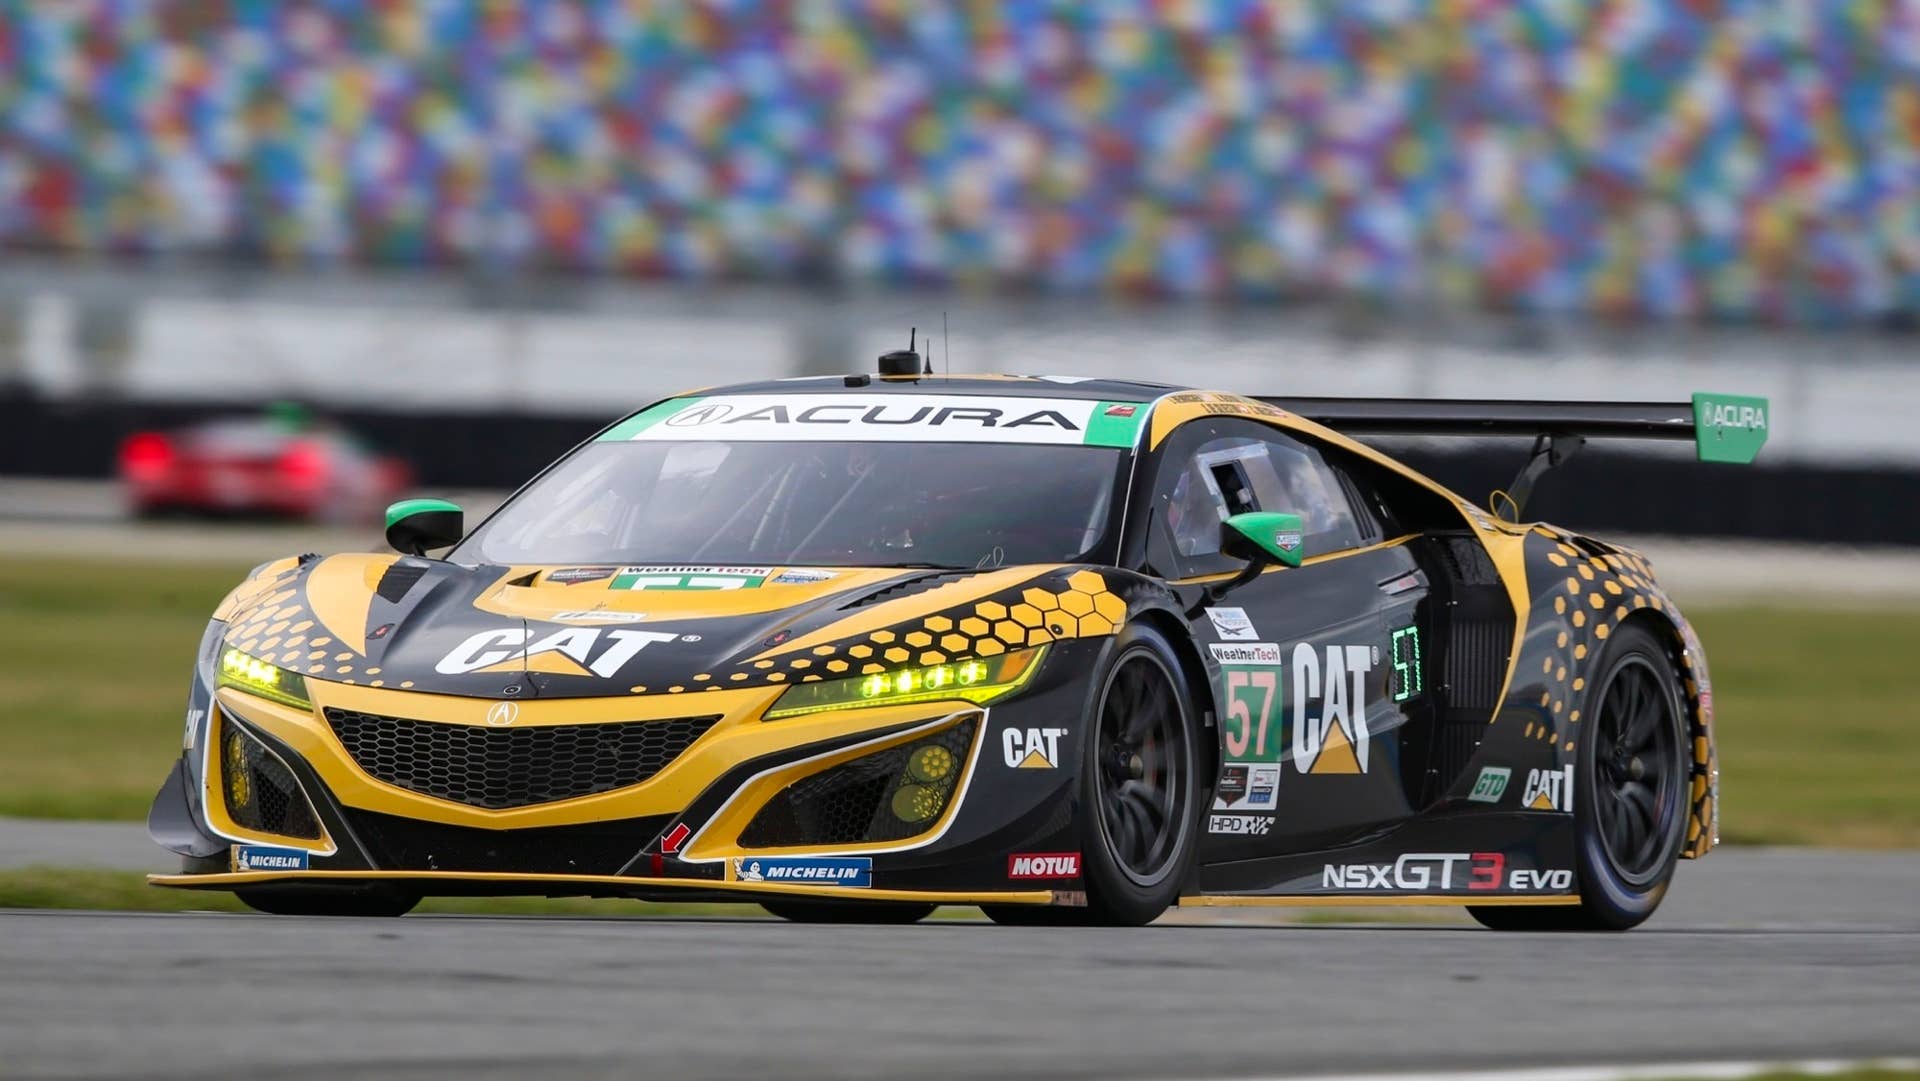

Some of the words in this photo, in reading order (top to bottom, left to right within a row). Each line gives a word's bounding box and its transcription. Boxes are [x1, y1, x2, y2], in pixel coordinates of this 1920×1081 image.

[721, 404, 1081, 430] ACURA
[1713, 404, 1766, 429] ACURA
[435, 628, 679, 679] CAT
[1212, 647, 1279, 660] WeatherTech
[1393, 626, 1421, 700] 57
[1226, 671, 1276, 758] 57
[1292, 642, 1371, 774] CAT
[1002, 728, 1062, 768] CAT
[1474, 773, 1506, 796] GTD
[1522, 768, 1564, 810] CAT
[1210, 817, 1242, 831] HPD
[250, 855, 301, 868] MICHELIN
[766, 866, 859, 879] MICHELIN
[1012, 856, 1077, 875] MOTUL
[1509, 870, 1573, 889] EVO
